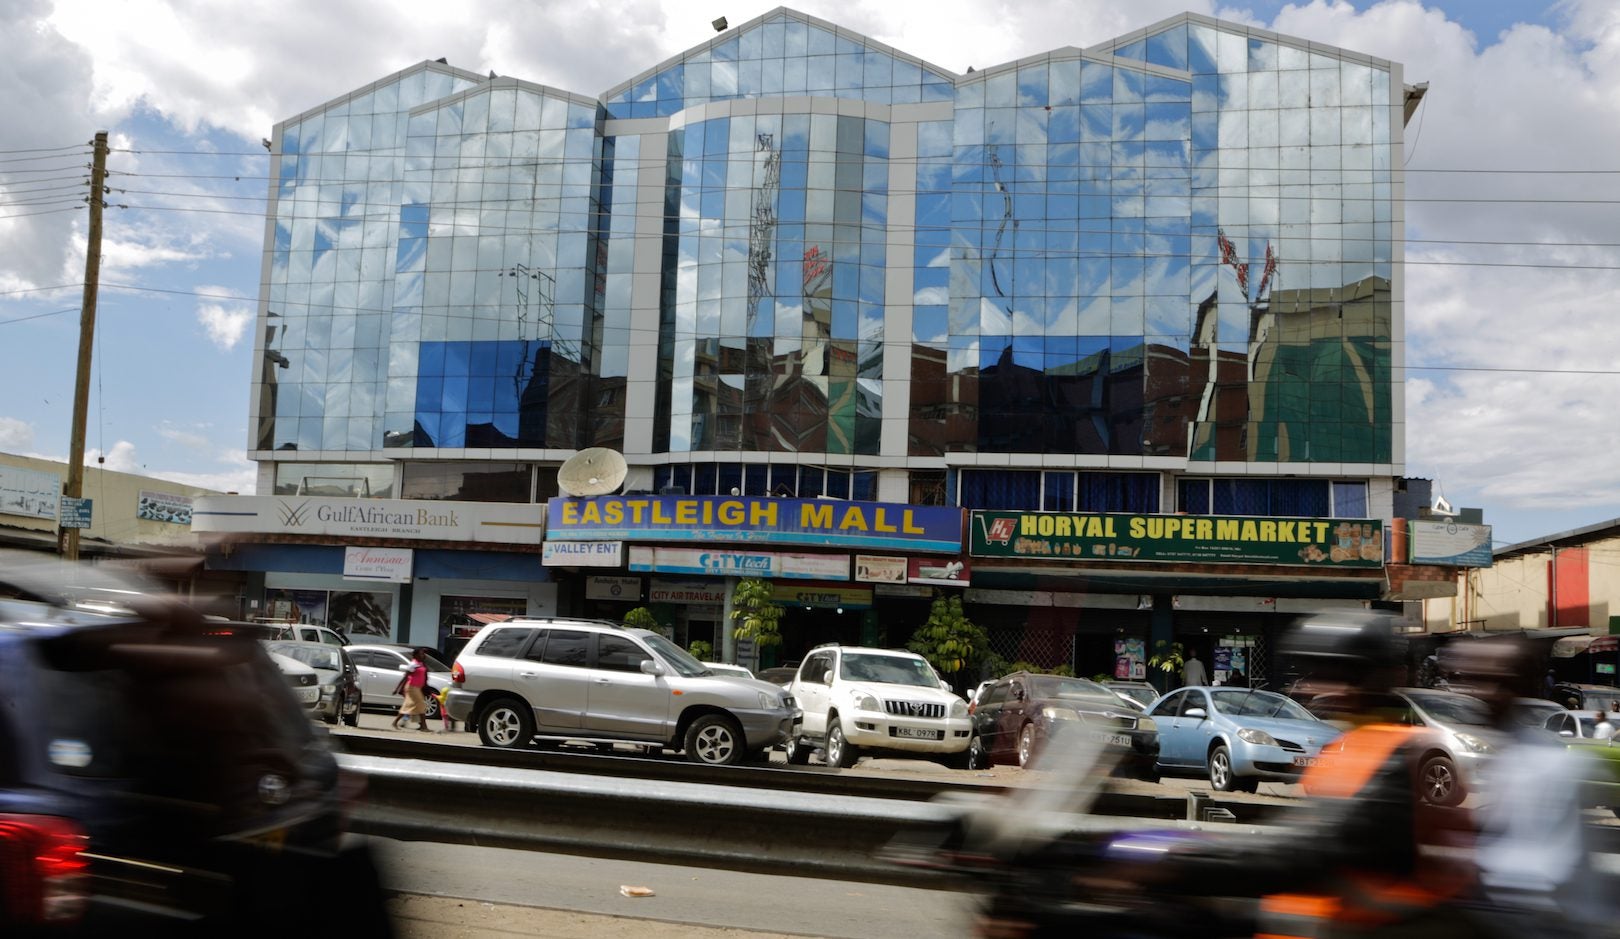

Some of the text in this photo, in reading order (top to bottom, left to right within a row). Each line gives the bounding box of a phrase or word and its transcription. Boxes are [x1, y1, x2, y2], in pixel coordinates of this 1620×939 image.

[317, 504, 459, 528] GulfAfrican Bank
[562, 500, 925, 535] EASTLEIGH MALL
[1020, 514, 1117, 538] HORYAL
[553, 543, 619, 554] VALLEY ENT
[671, 591, 684, 601] AIR
[685, 592, 715, 602] TRAVEL
[1110, 735, 1130, 745] 751U
